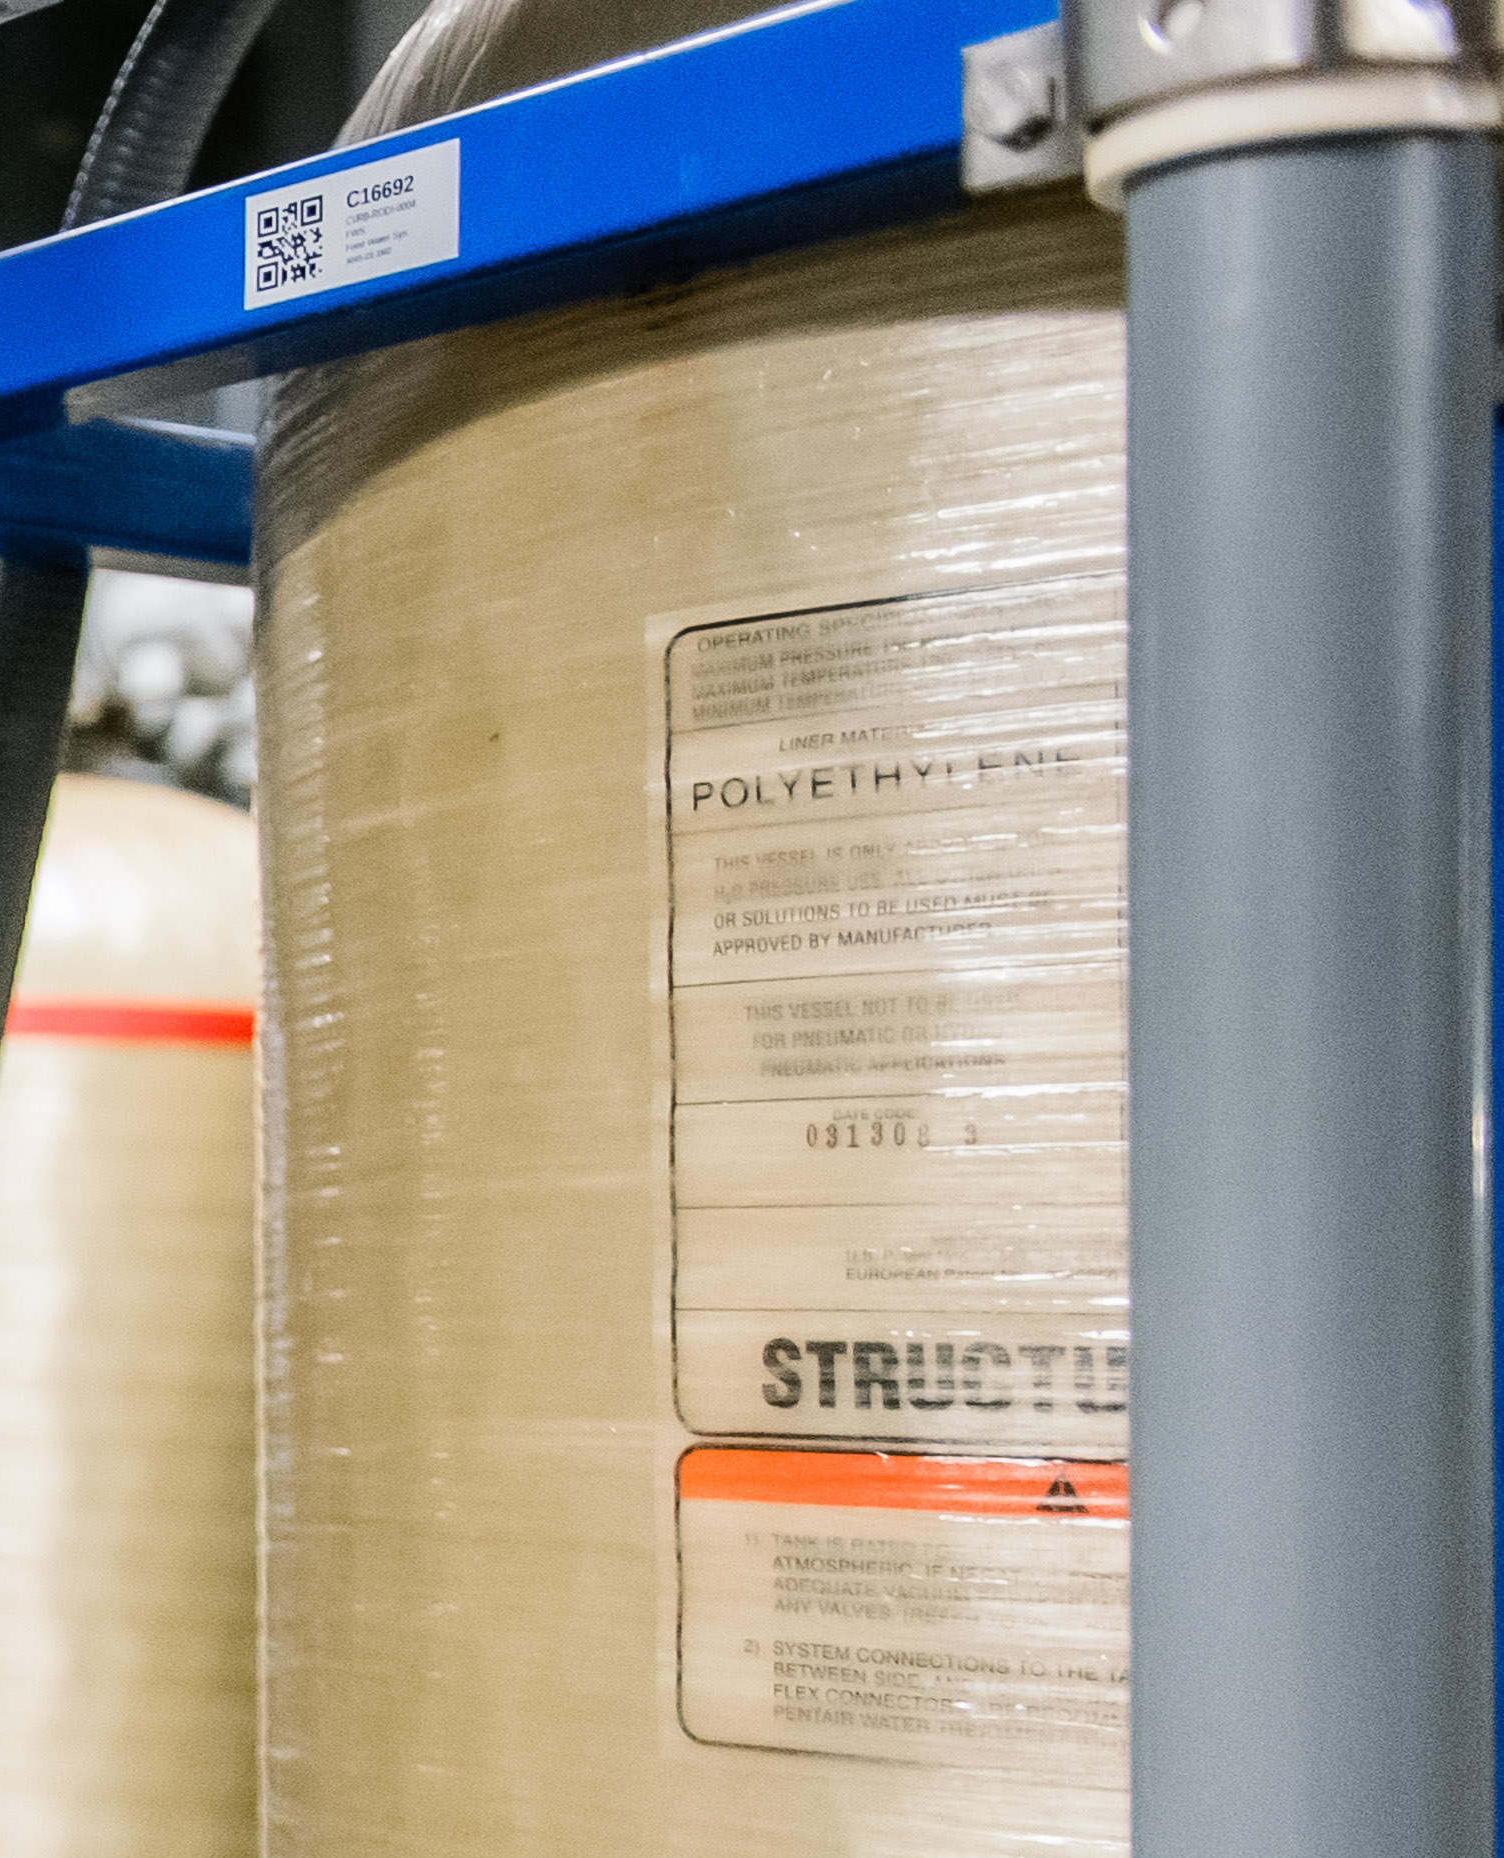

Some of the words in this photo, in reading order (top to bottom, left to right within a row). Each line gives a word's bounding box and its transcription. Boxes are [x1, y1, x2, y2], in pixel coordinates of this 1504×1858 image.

[346, 175, 414, 208] C16692
[696, 623, 811, 653] OPERATING
[779, 732, 835, 753] LINER
[714, 912, 737, 930] OR
[741, 903, 840, 928] SOLUTIONS
[848, 901, 870, 917] TO
[877, 899, 899, 916] BE
[713, 934, 802, 957] APPROVED
[808, 932, 830, 949] BY
[745, 1003, 785, 1021] THIS
[789, 999, 857, 1019] VESSEL
[863, 998, 897, 1016] NOT
[753, 1031, 786, 1049] FOR
[792, 1027, 894, 1048] PNEUMATIC
[744, 1639, 760, 1655] 2)
[773, 1640, 850, 1661] SYSTEM
[856, 1647, 1010, 1674] CONNECTIONS
[1021, 1658, 1046, 1677] TO
[773, 1662, 867, 1684] BETWEEN
[773, 1683, 819, 1701] FLEX
[773, 1705, 854, 1725] PENTAIR
[860, 1713, 931, 1733] WATER
